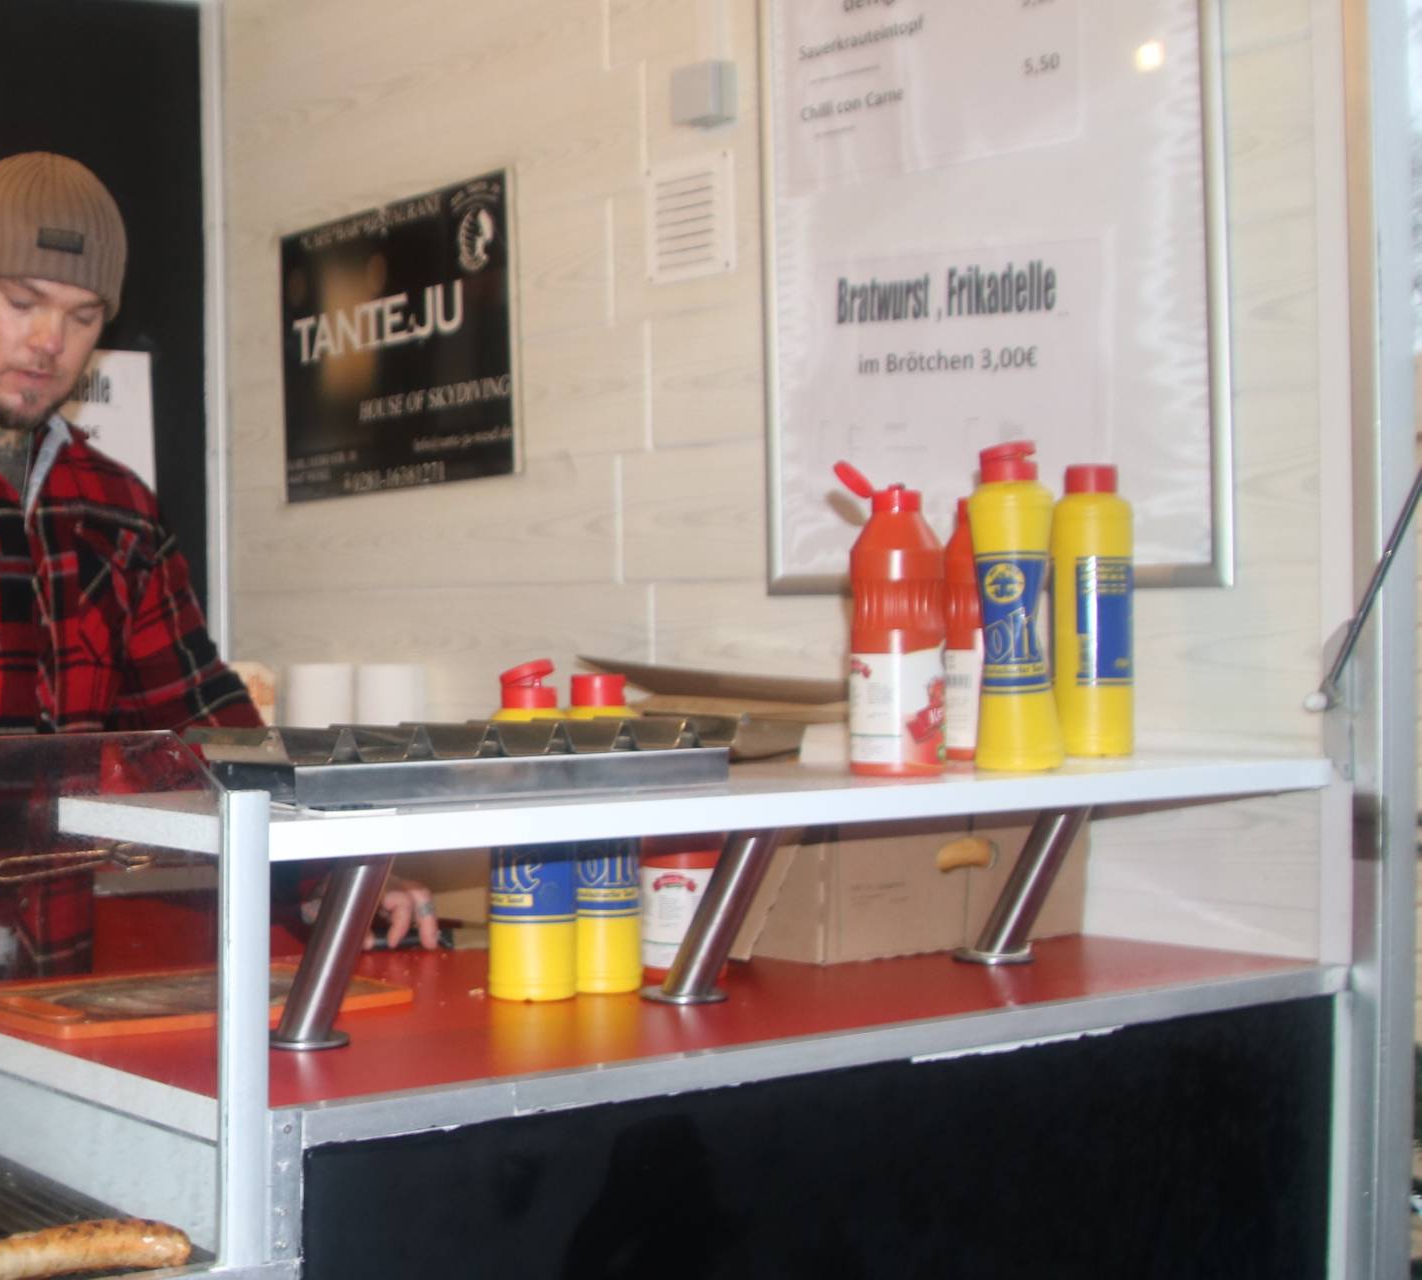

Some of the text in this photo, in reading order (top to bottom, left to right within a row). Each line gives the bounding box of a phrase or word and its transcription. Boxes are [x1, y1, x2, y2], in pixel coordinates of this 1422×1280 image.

[797, 14, 925, 62] Sauerkrauteintopf
[1023, 51, 1061, 76] 5,50
[836, 97, 863, 114] con
[836, 274, 931, 325] Bratwurst
[947, 259, 1058, 318] Frikadelle
[858, 345, 1039, 375] im Brötchen 3,00€
[359, 374, 511, 424] HOUSE OF SKYDIVING
